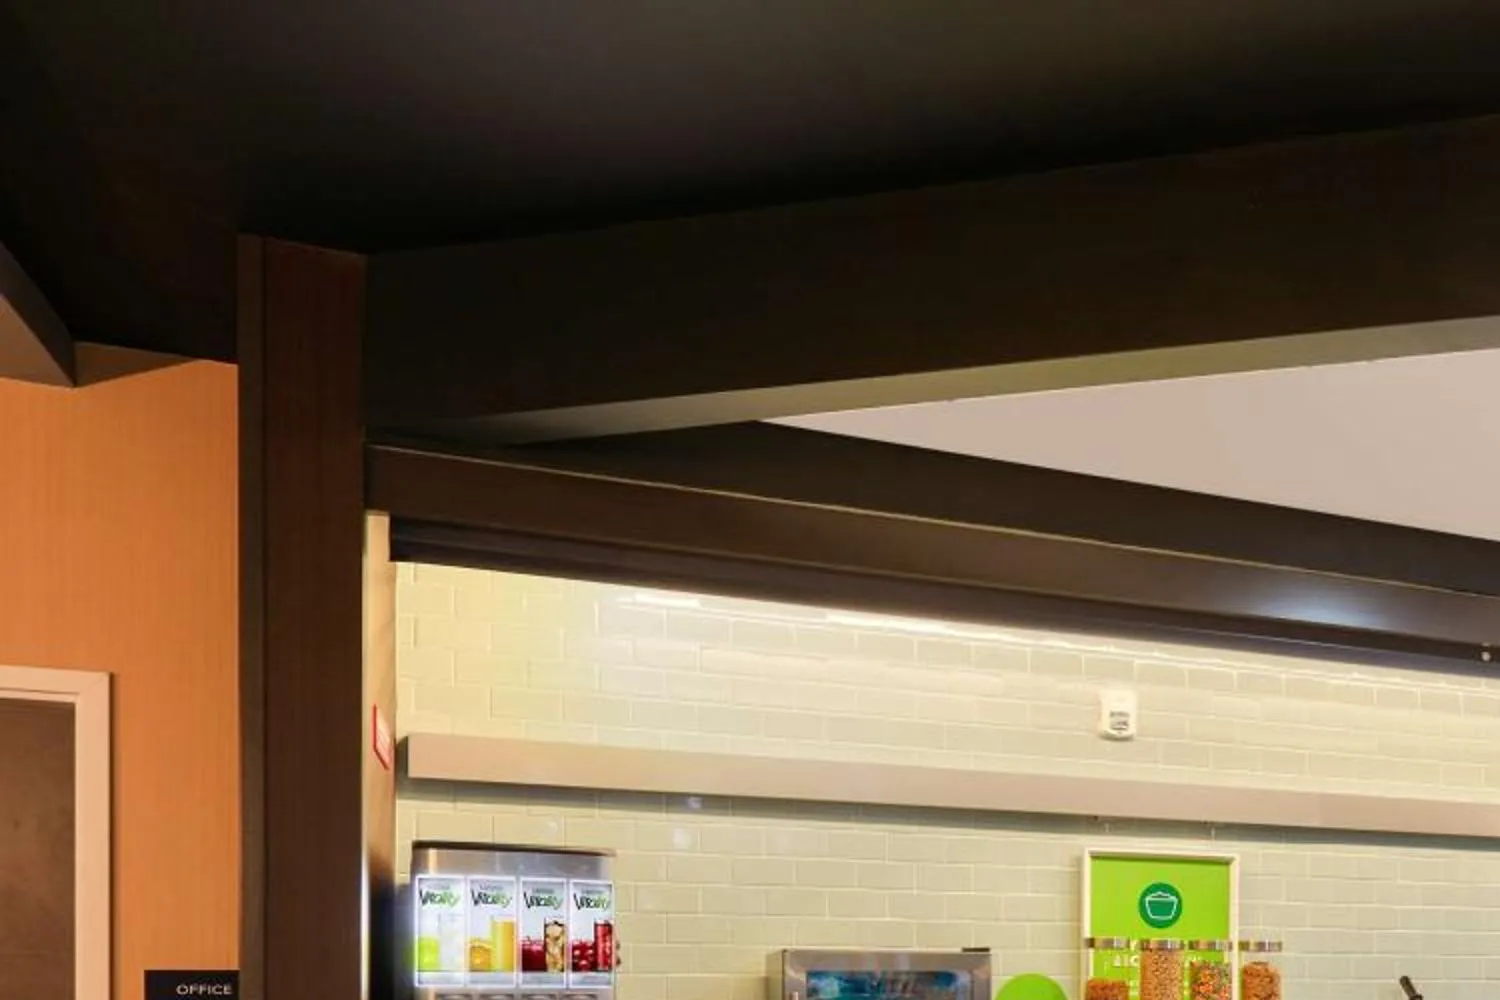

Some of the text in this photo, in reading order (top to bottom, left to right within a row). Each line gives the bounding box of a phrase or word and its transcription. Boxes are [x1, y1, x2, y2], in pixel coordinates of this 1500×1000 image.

[470, 888, 513, 908] Vitality
[523, 891, 563, 910] Vitality
[573, 892, 611, 910] Vitality
[175, 983, 233, 995] OFFICE
